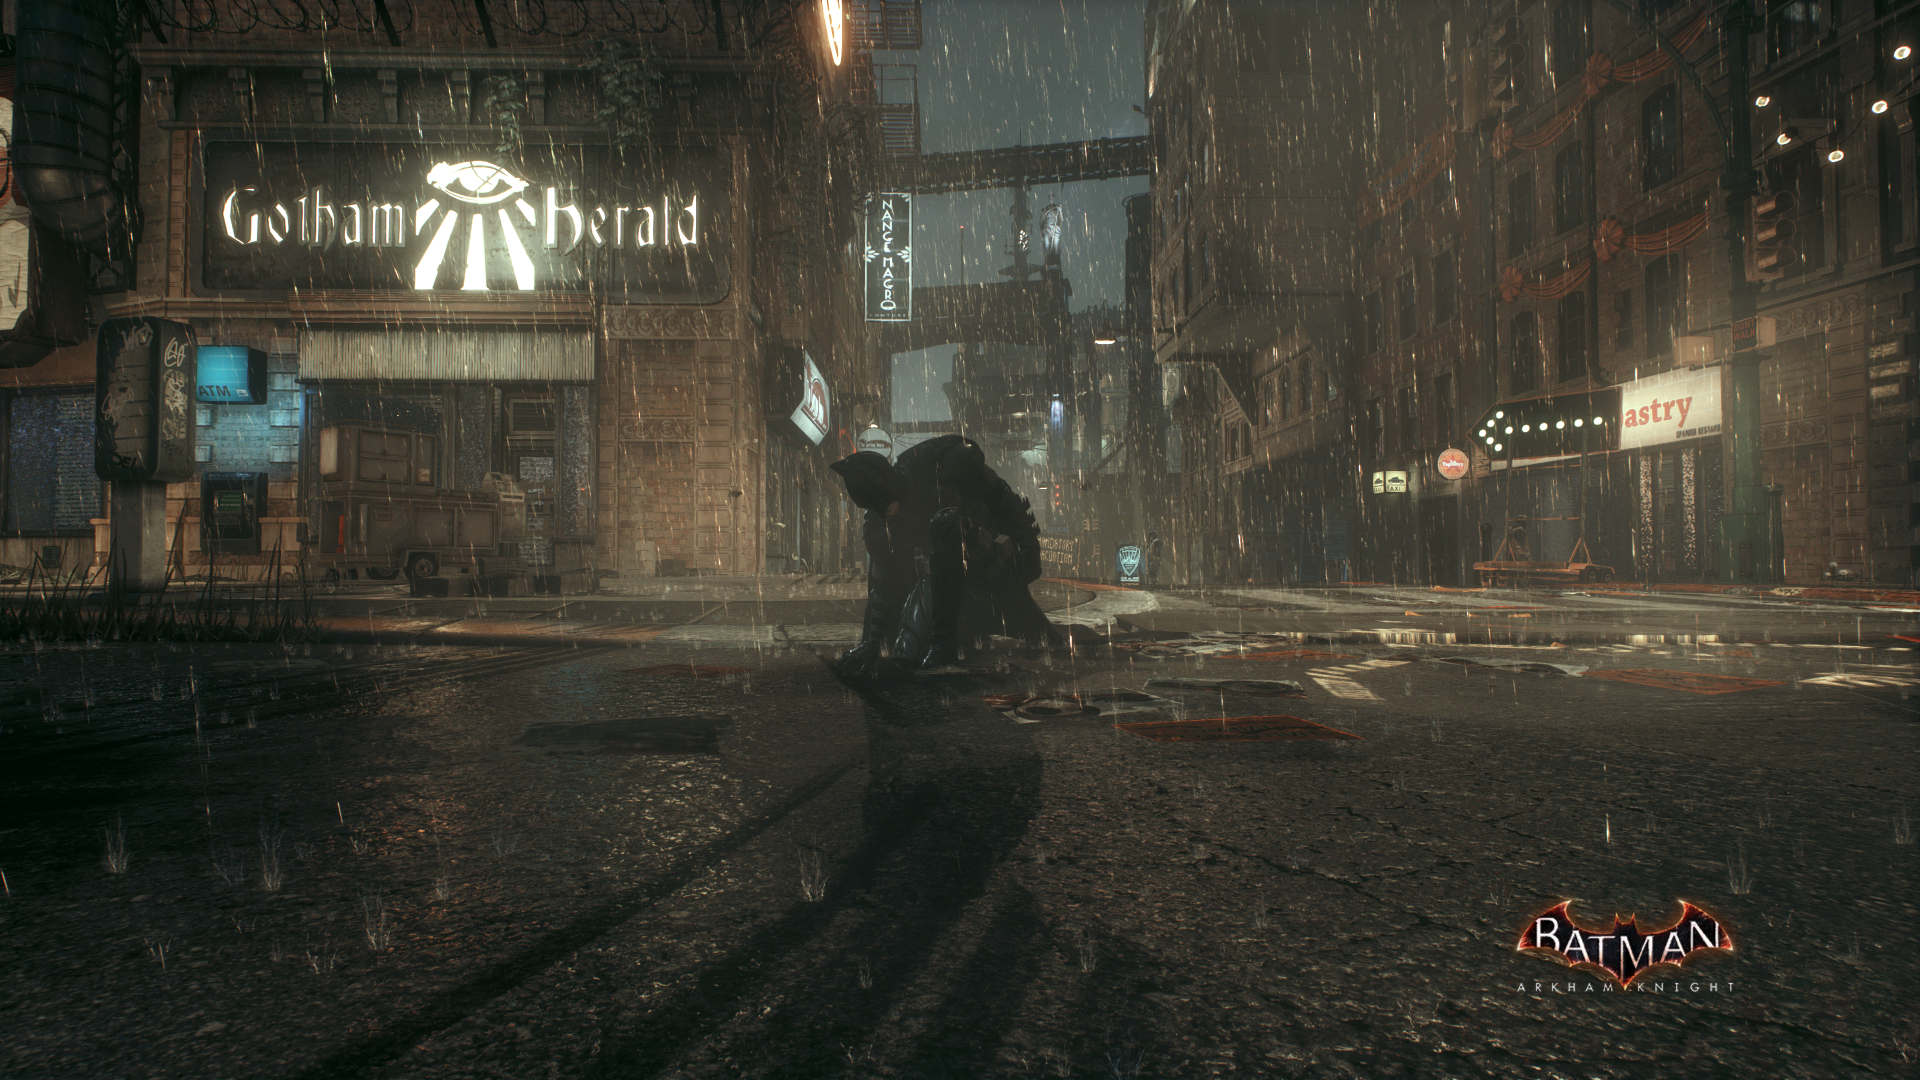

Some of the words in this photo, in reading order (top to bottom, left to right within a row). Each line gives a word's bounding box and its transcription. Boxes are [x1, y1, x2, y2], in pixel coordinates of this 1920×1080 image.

[219, 185, 406, 252] Gotham
[544, 184, 701, 254] Herald
[881, 199, 893, 253] NANGE
[880, 256, 896, 311] MAGRO
[1733, 318, 1755, 332] DONT
[1733, 327, 1756, 341] WALK
[198, 385, 231, 396] ATM
[1622, 396, 1692, 428] astry
[1675, 428, 1697, 438] SPANISH
[1698, 424, 1721, 435] RESTAUR
[1040, 550, 1073, 564] ACUATION
